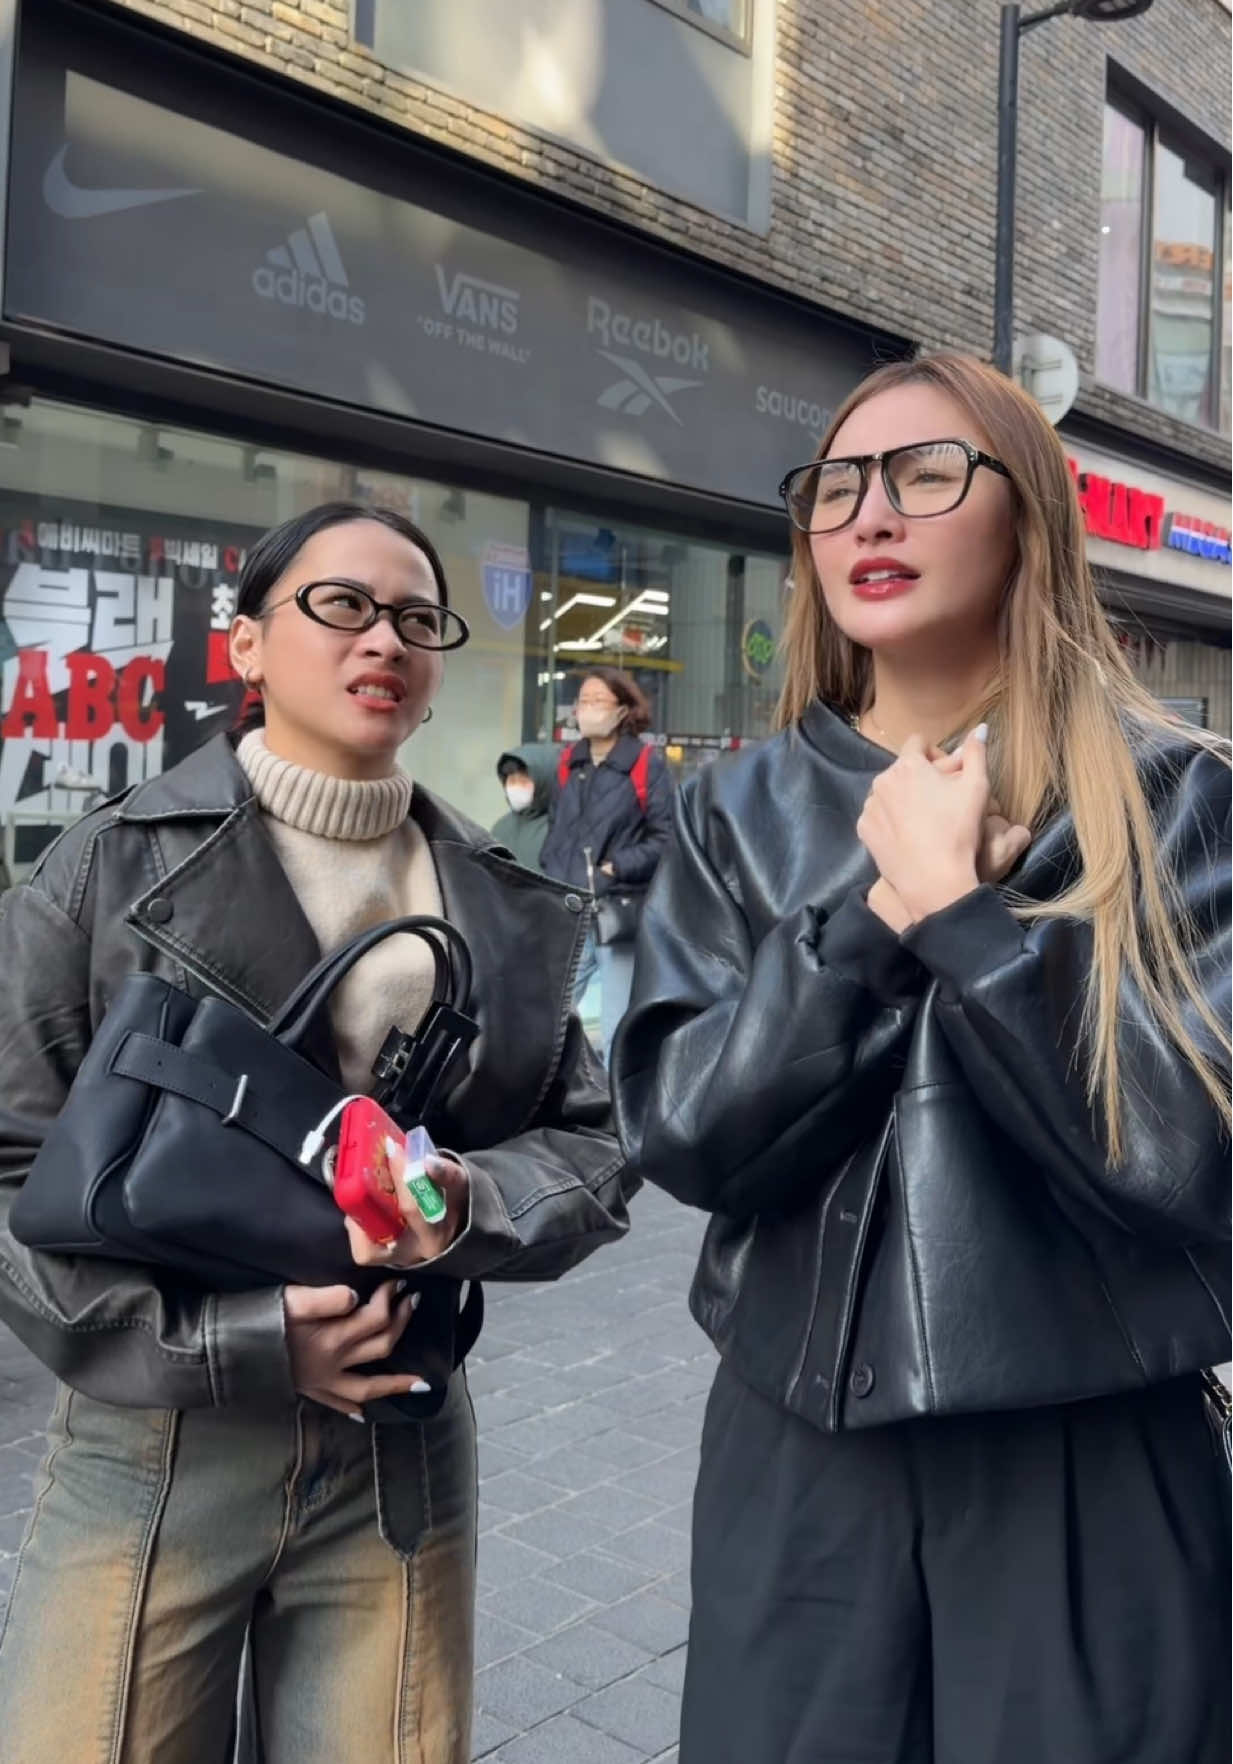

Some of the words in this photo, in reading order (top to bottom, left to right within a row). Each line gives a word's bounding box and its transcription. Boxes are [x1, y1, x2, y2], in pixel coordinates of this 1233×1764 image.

[252, 266, 366, 325] adidas
[434, 263, 520, 334] VANS
[587, 295, 711, 371] Reebok
[756, 384, 834, 432] saucon
[1, 649, 166, 743] ABC
